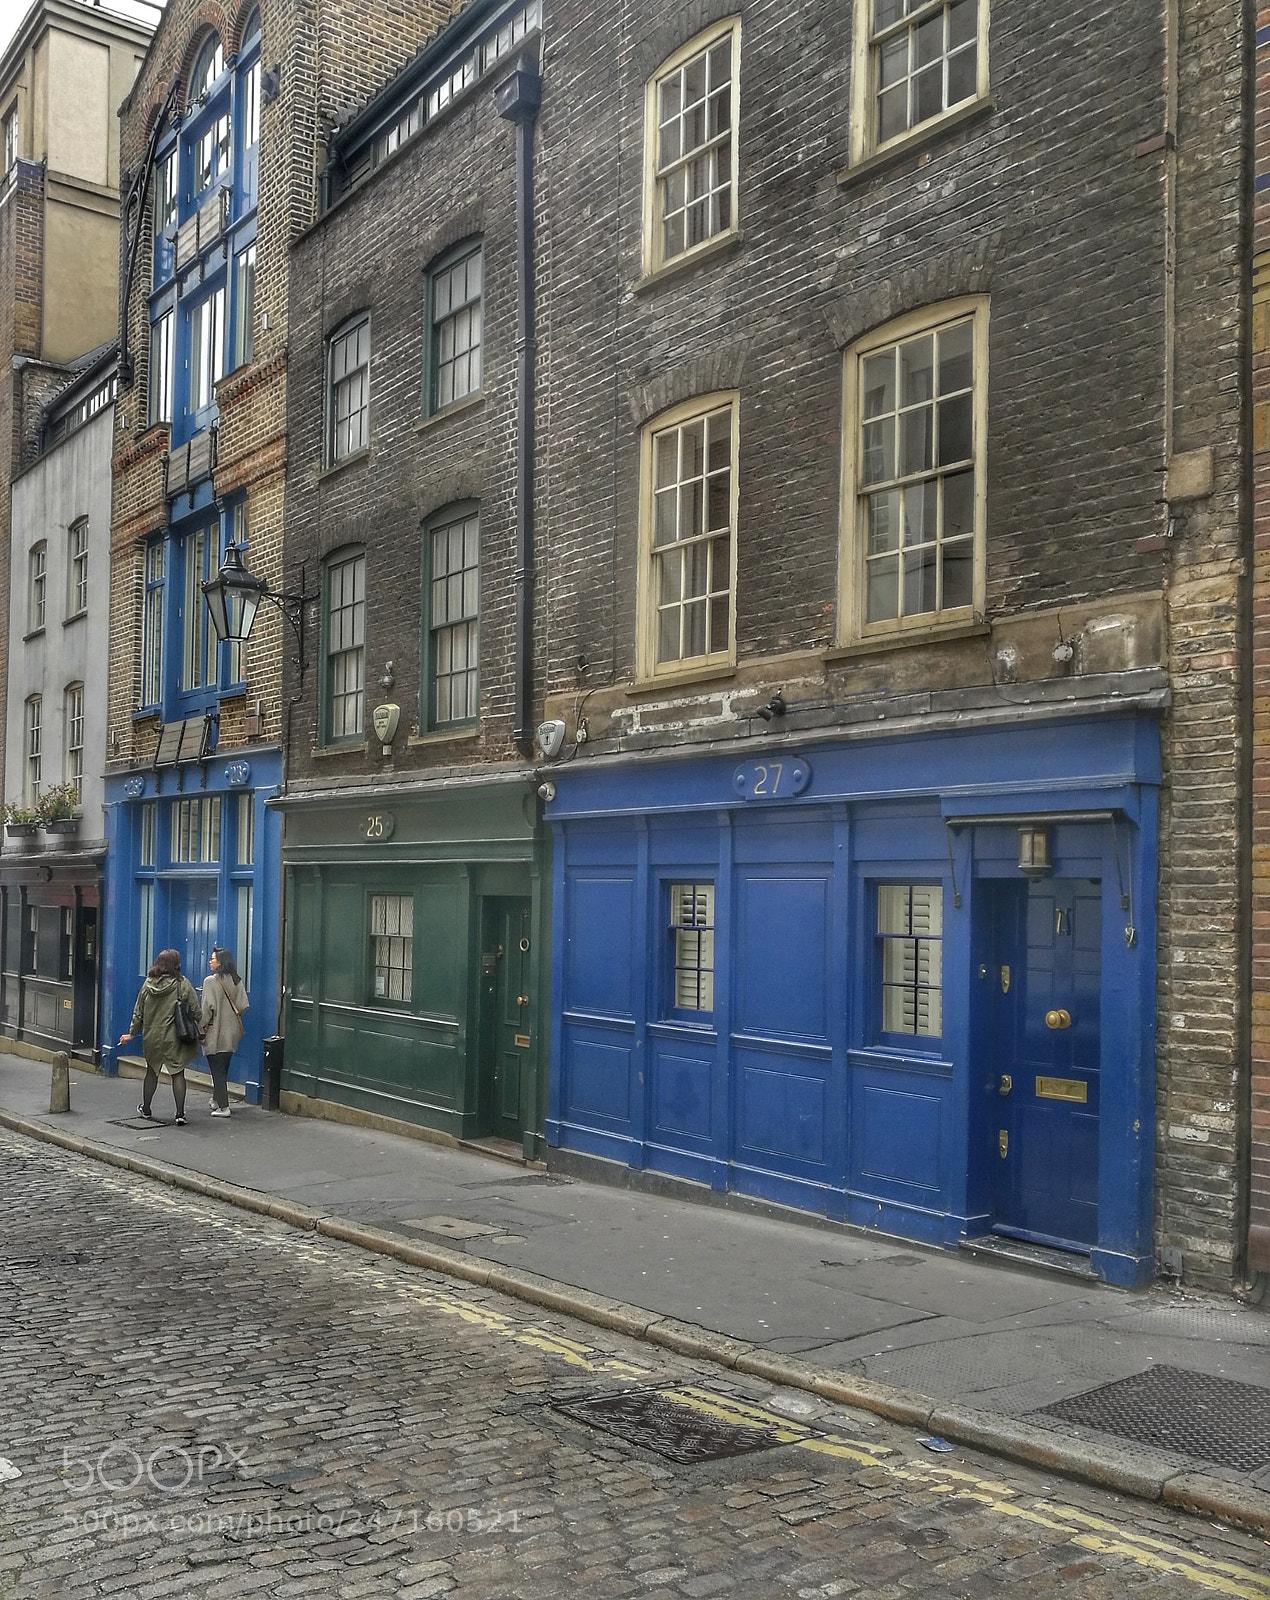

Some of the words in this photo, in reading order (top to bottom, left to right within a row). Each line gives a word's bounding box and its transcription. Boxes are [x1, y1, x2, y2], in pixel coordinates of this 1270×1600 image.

[229, 764, 243, 783] 23
[754, 763, 783, 795] 27
[366, 816, 383, 837] 25
